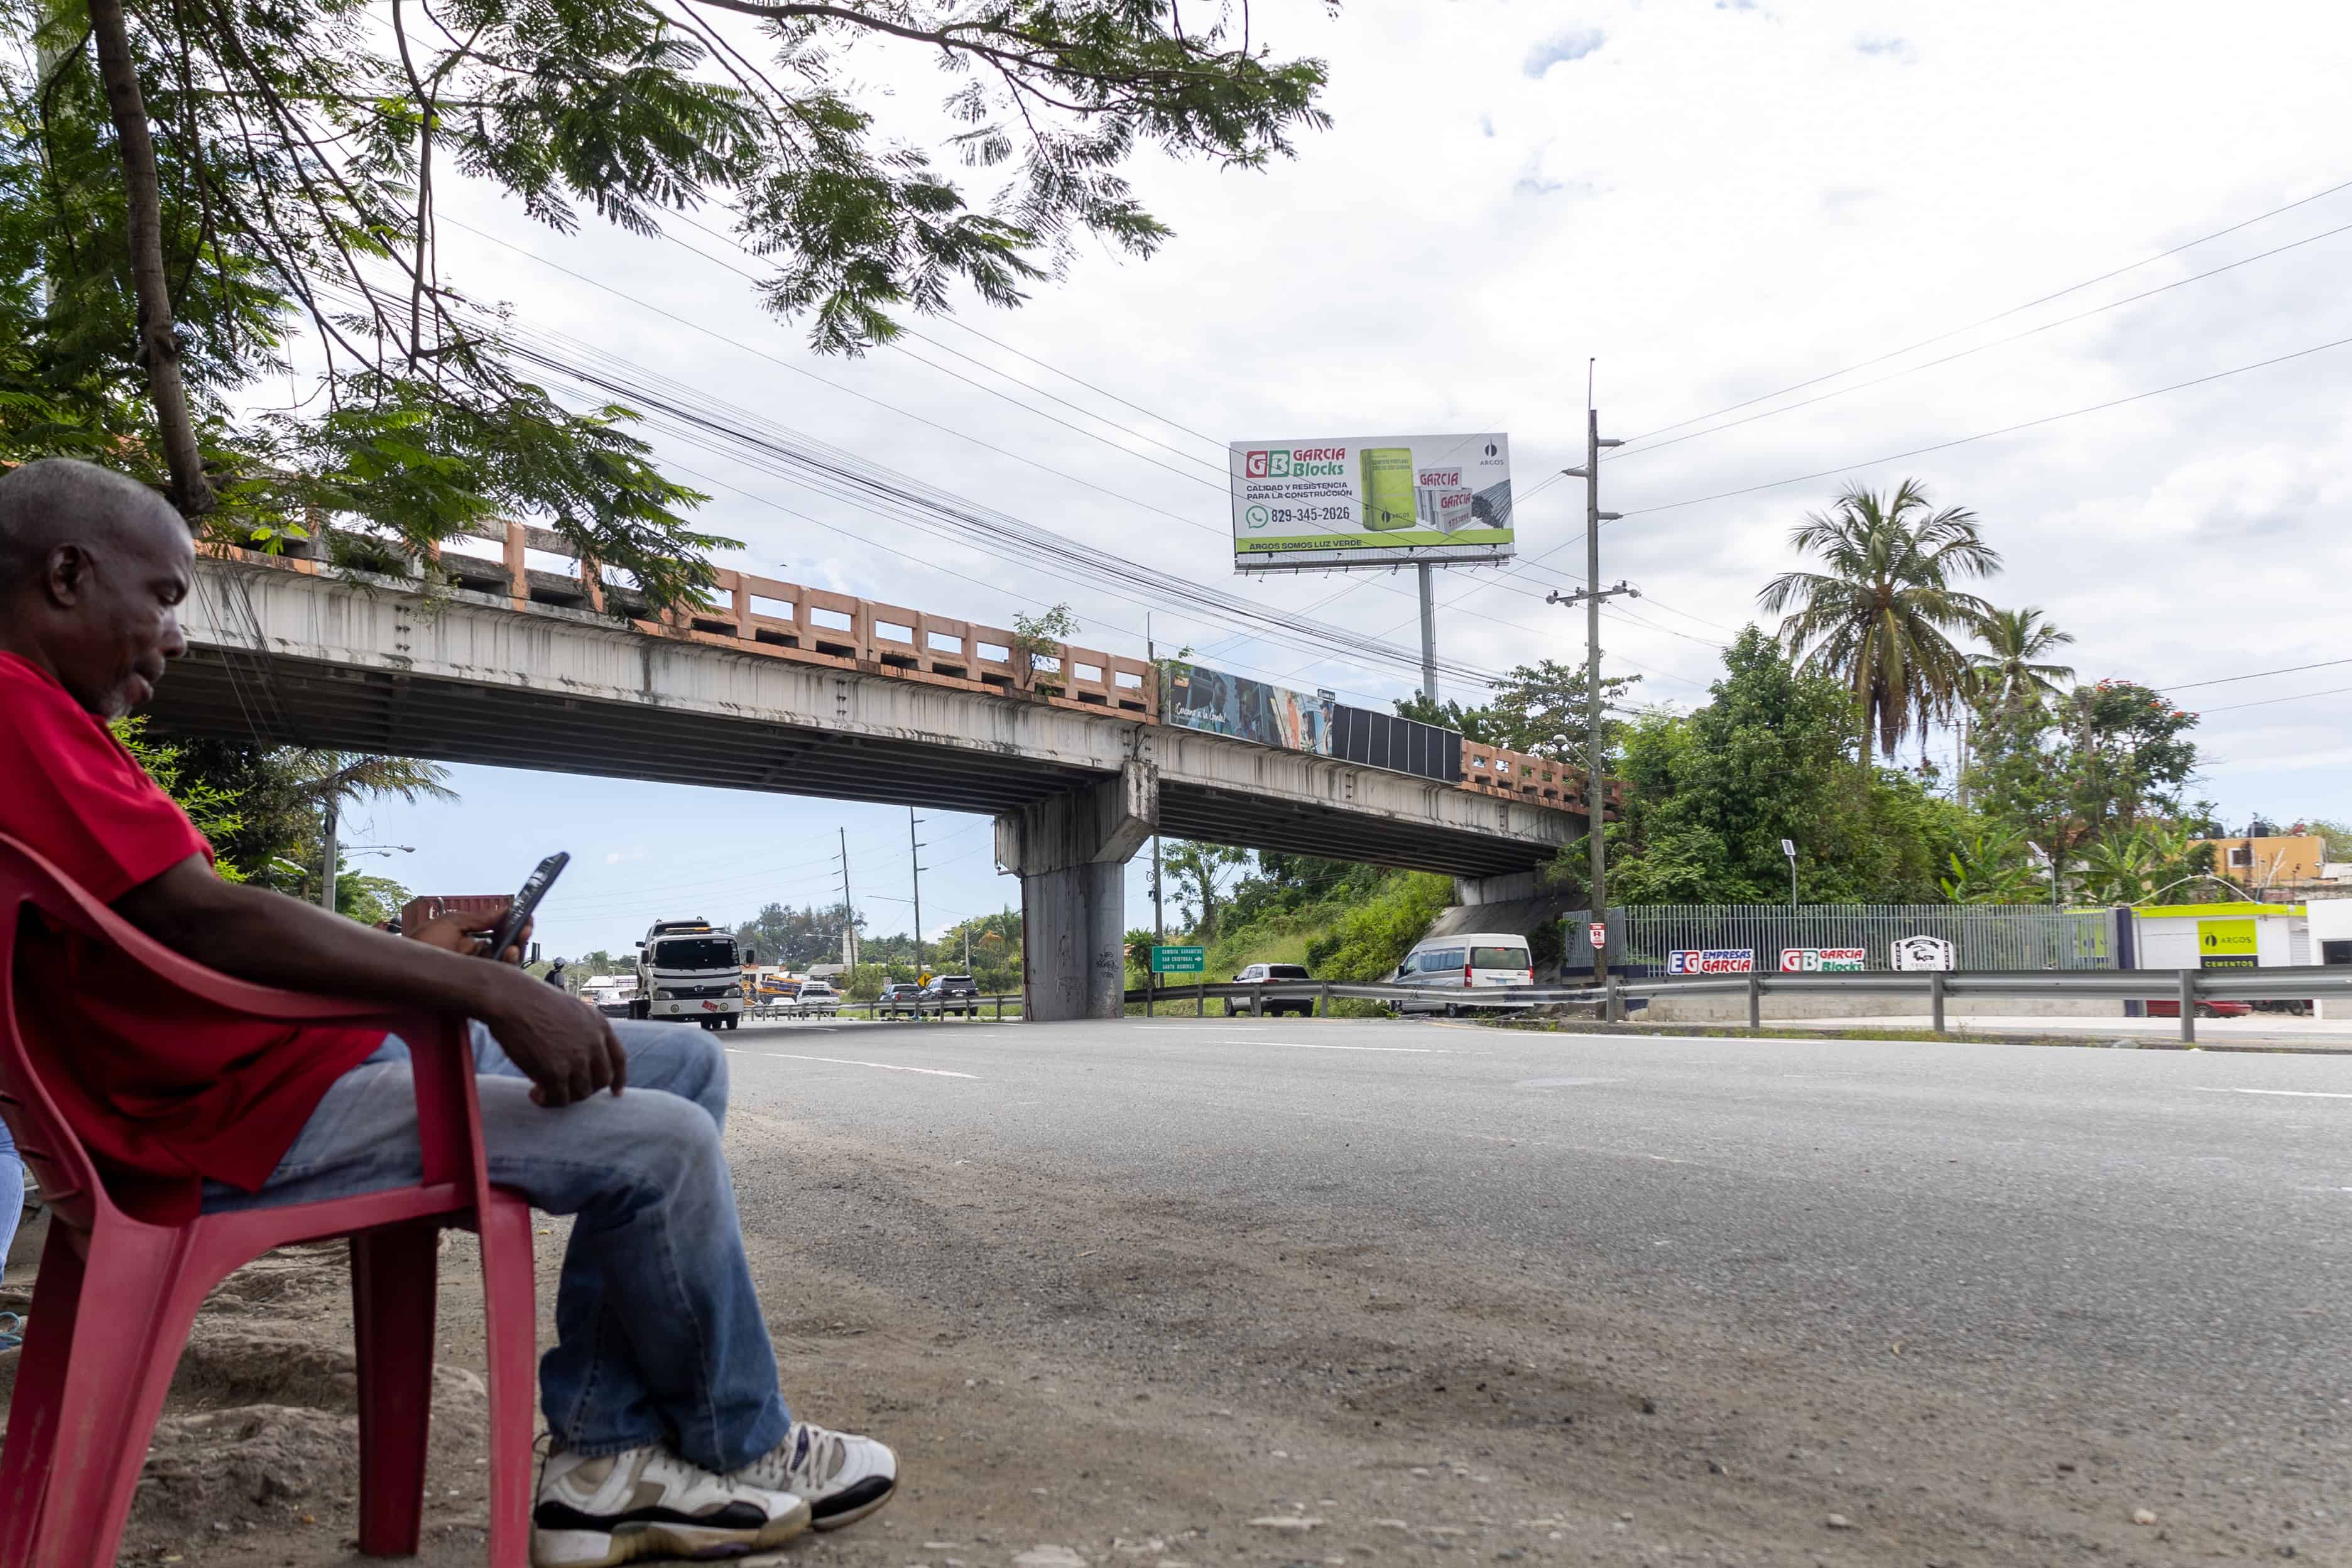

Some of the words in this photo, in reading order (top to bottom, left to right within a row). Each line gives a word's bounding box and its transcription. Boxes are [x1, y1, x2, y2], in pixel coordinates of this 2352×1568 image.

[1293, 448, 1346, 462] GARCIA
[1293, 462, 1344, 477] Blocks
[1420, 472, 1459, 486] GARCIA
[1292, 482, 1348, 490] RESISTENCIA
[1285, 489, 1352, 499] CONSTRUCCIÓN
[1441, 493, 1471, 509] GARCIA
[1271, 506, 1350, 522] 829-345-2026
[1250, 542, 1280, 550] ARGOS
[1282, 541, 1313, 550] SOMOS
[1314, 540, 1331, 548] LUZ
[1332, 539, 1363, 547] VERDE
[1702, 950, 1751, 959] EMPRESAS
[1820, 950, 1863, 959] GARCIA
[1670, 952, 1699, 973] EG
[1702, 960, 1751, 972] GARCIA
[1822, 961, 1862, 971] Blocks
